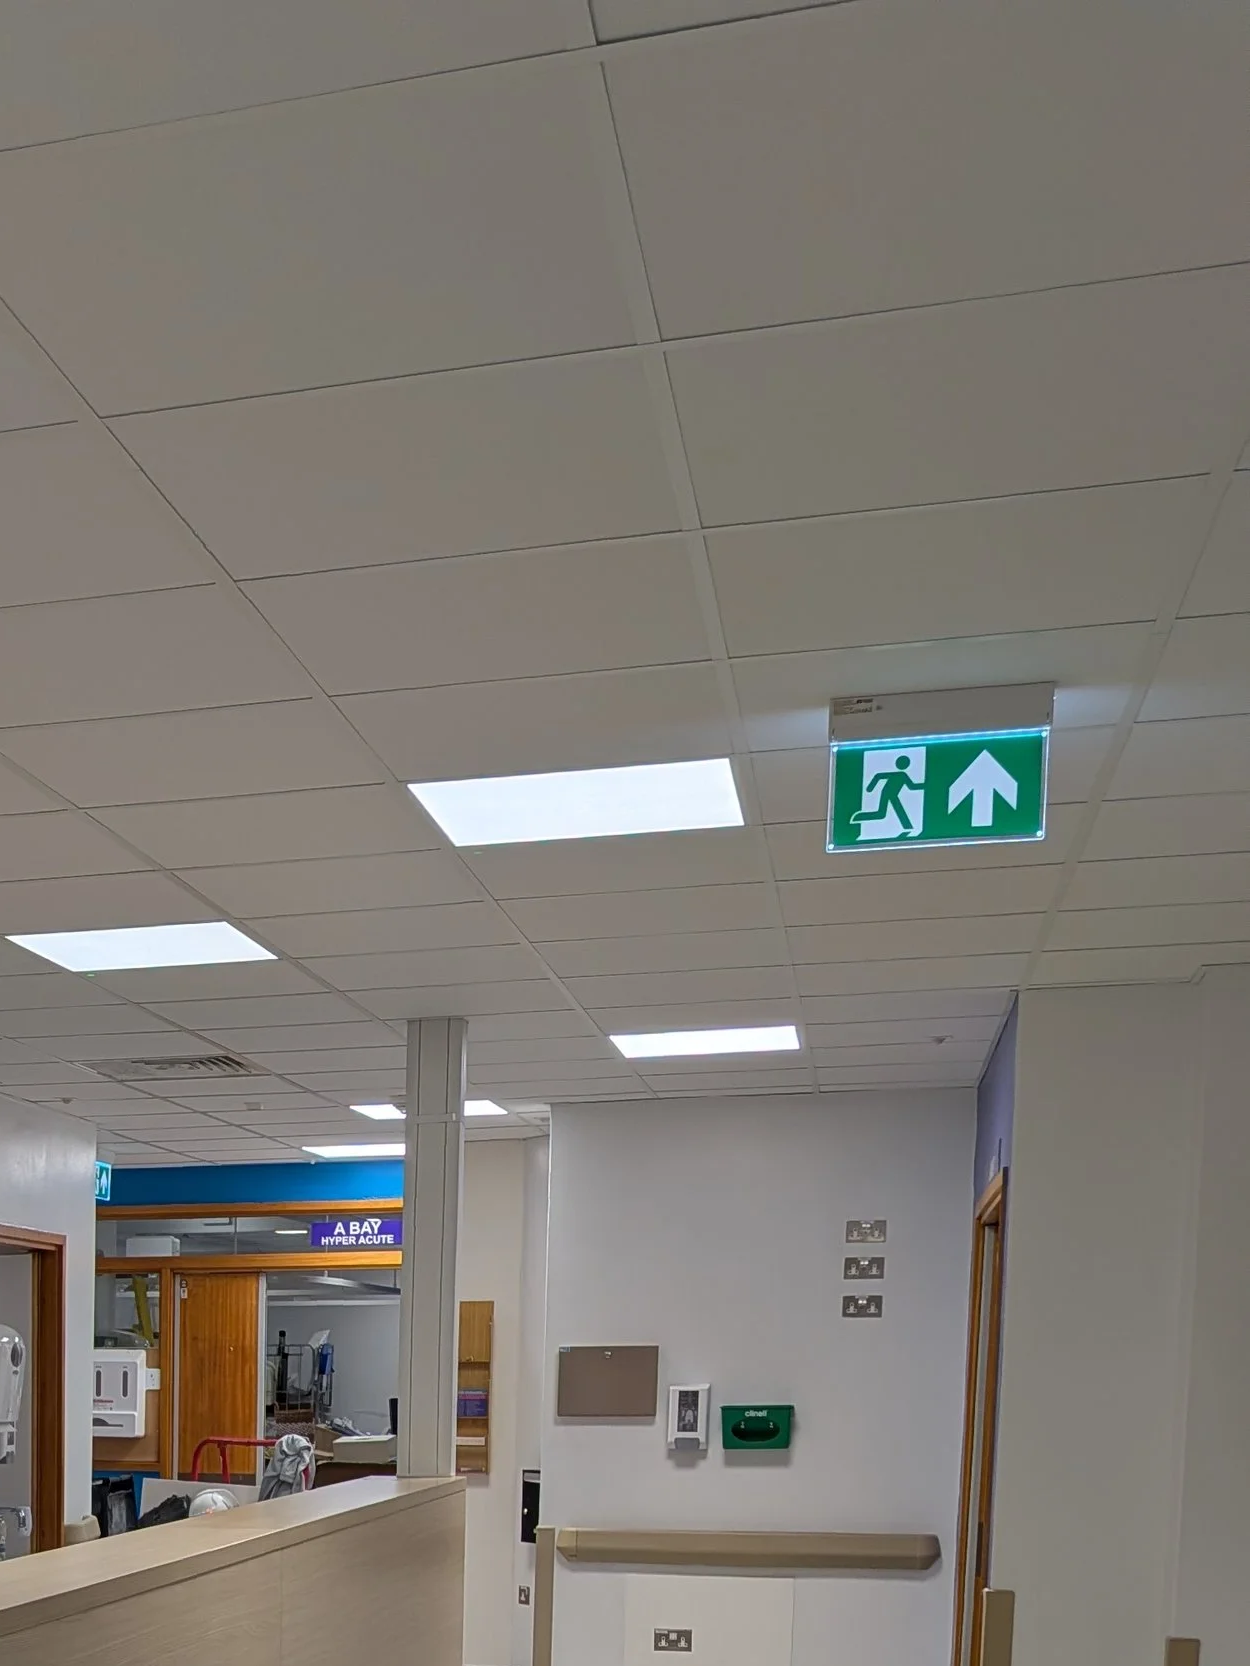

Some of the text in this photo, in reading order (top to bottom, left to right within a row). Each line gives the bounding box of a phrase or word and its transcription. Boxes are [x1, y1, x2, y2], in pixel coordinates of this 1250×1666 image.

[334, 1220, 381, 1235] A BAY
[321, 1235, 394, 1246] HYPER ACUTE
